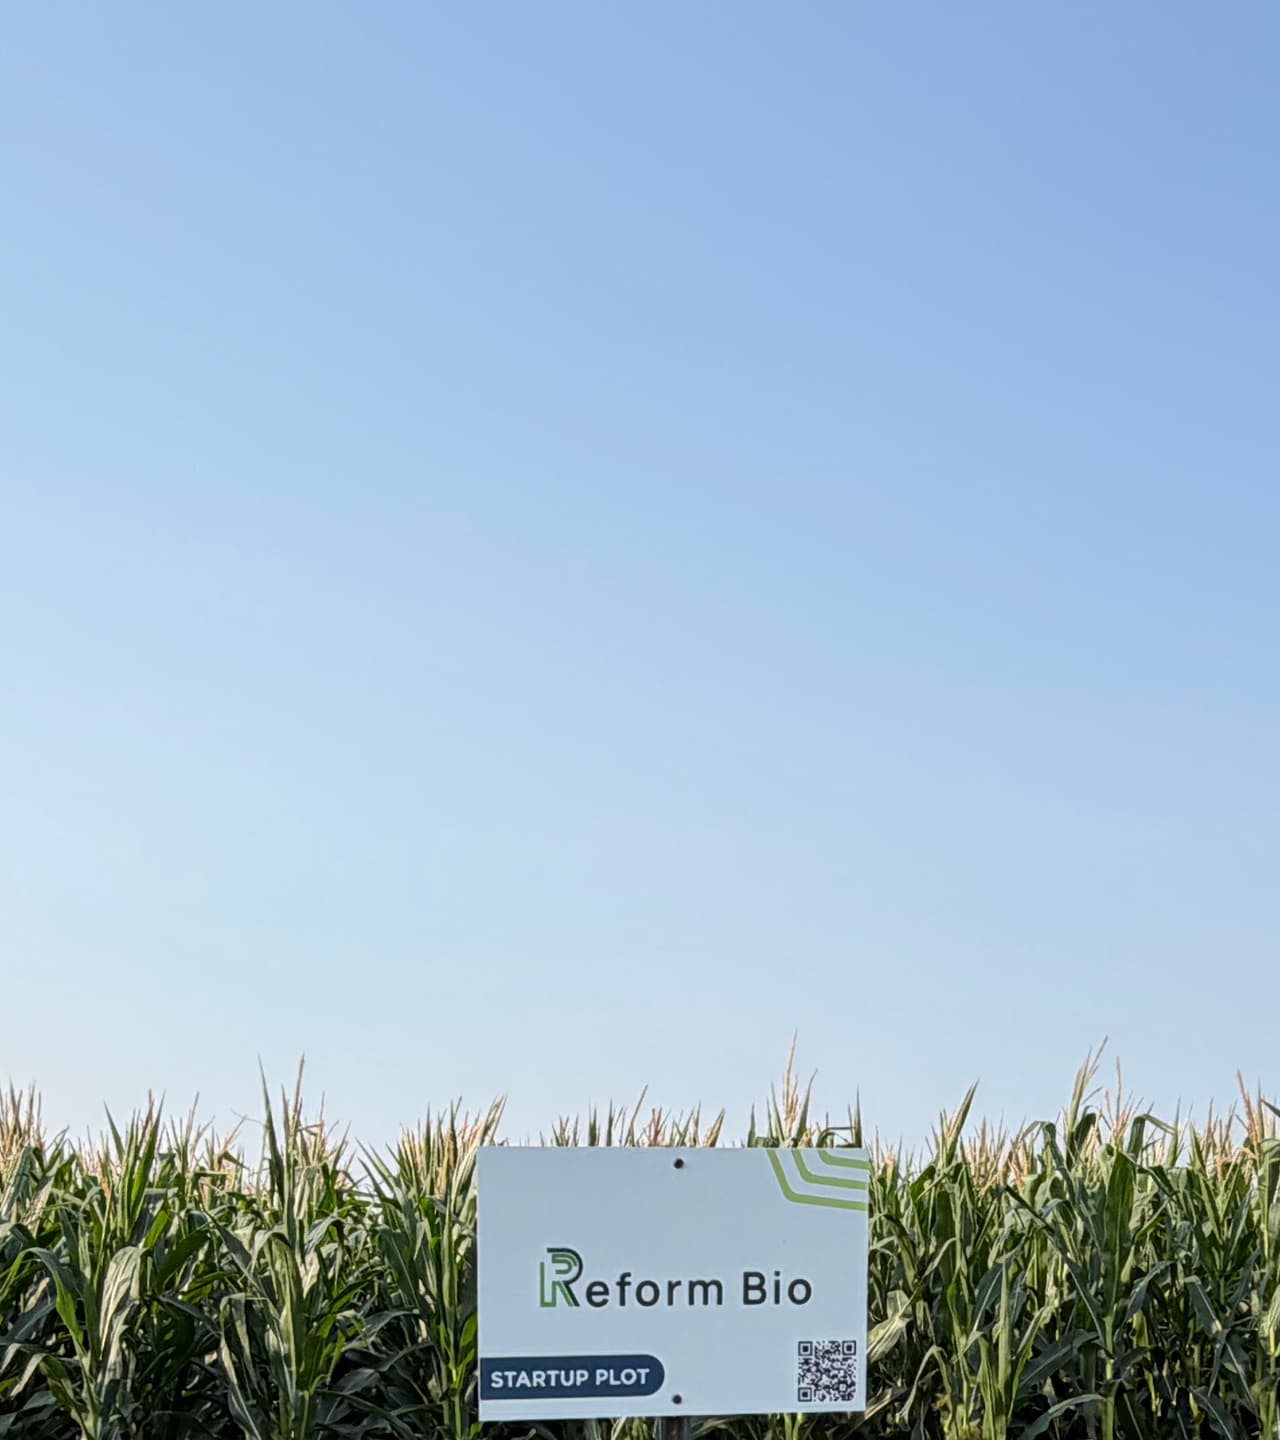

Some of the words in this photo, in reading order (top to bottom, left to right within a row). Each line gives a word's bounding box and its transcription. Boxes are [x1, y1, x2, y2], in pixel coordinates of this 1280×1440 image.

[540, 1248, 723, 1308] Reform
[743, 1271, 812, 1305] Bio
[491, 1370, 589, 1388] STARTUP
[596, 1368, 650, 1386] PLOT
